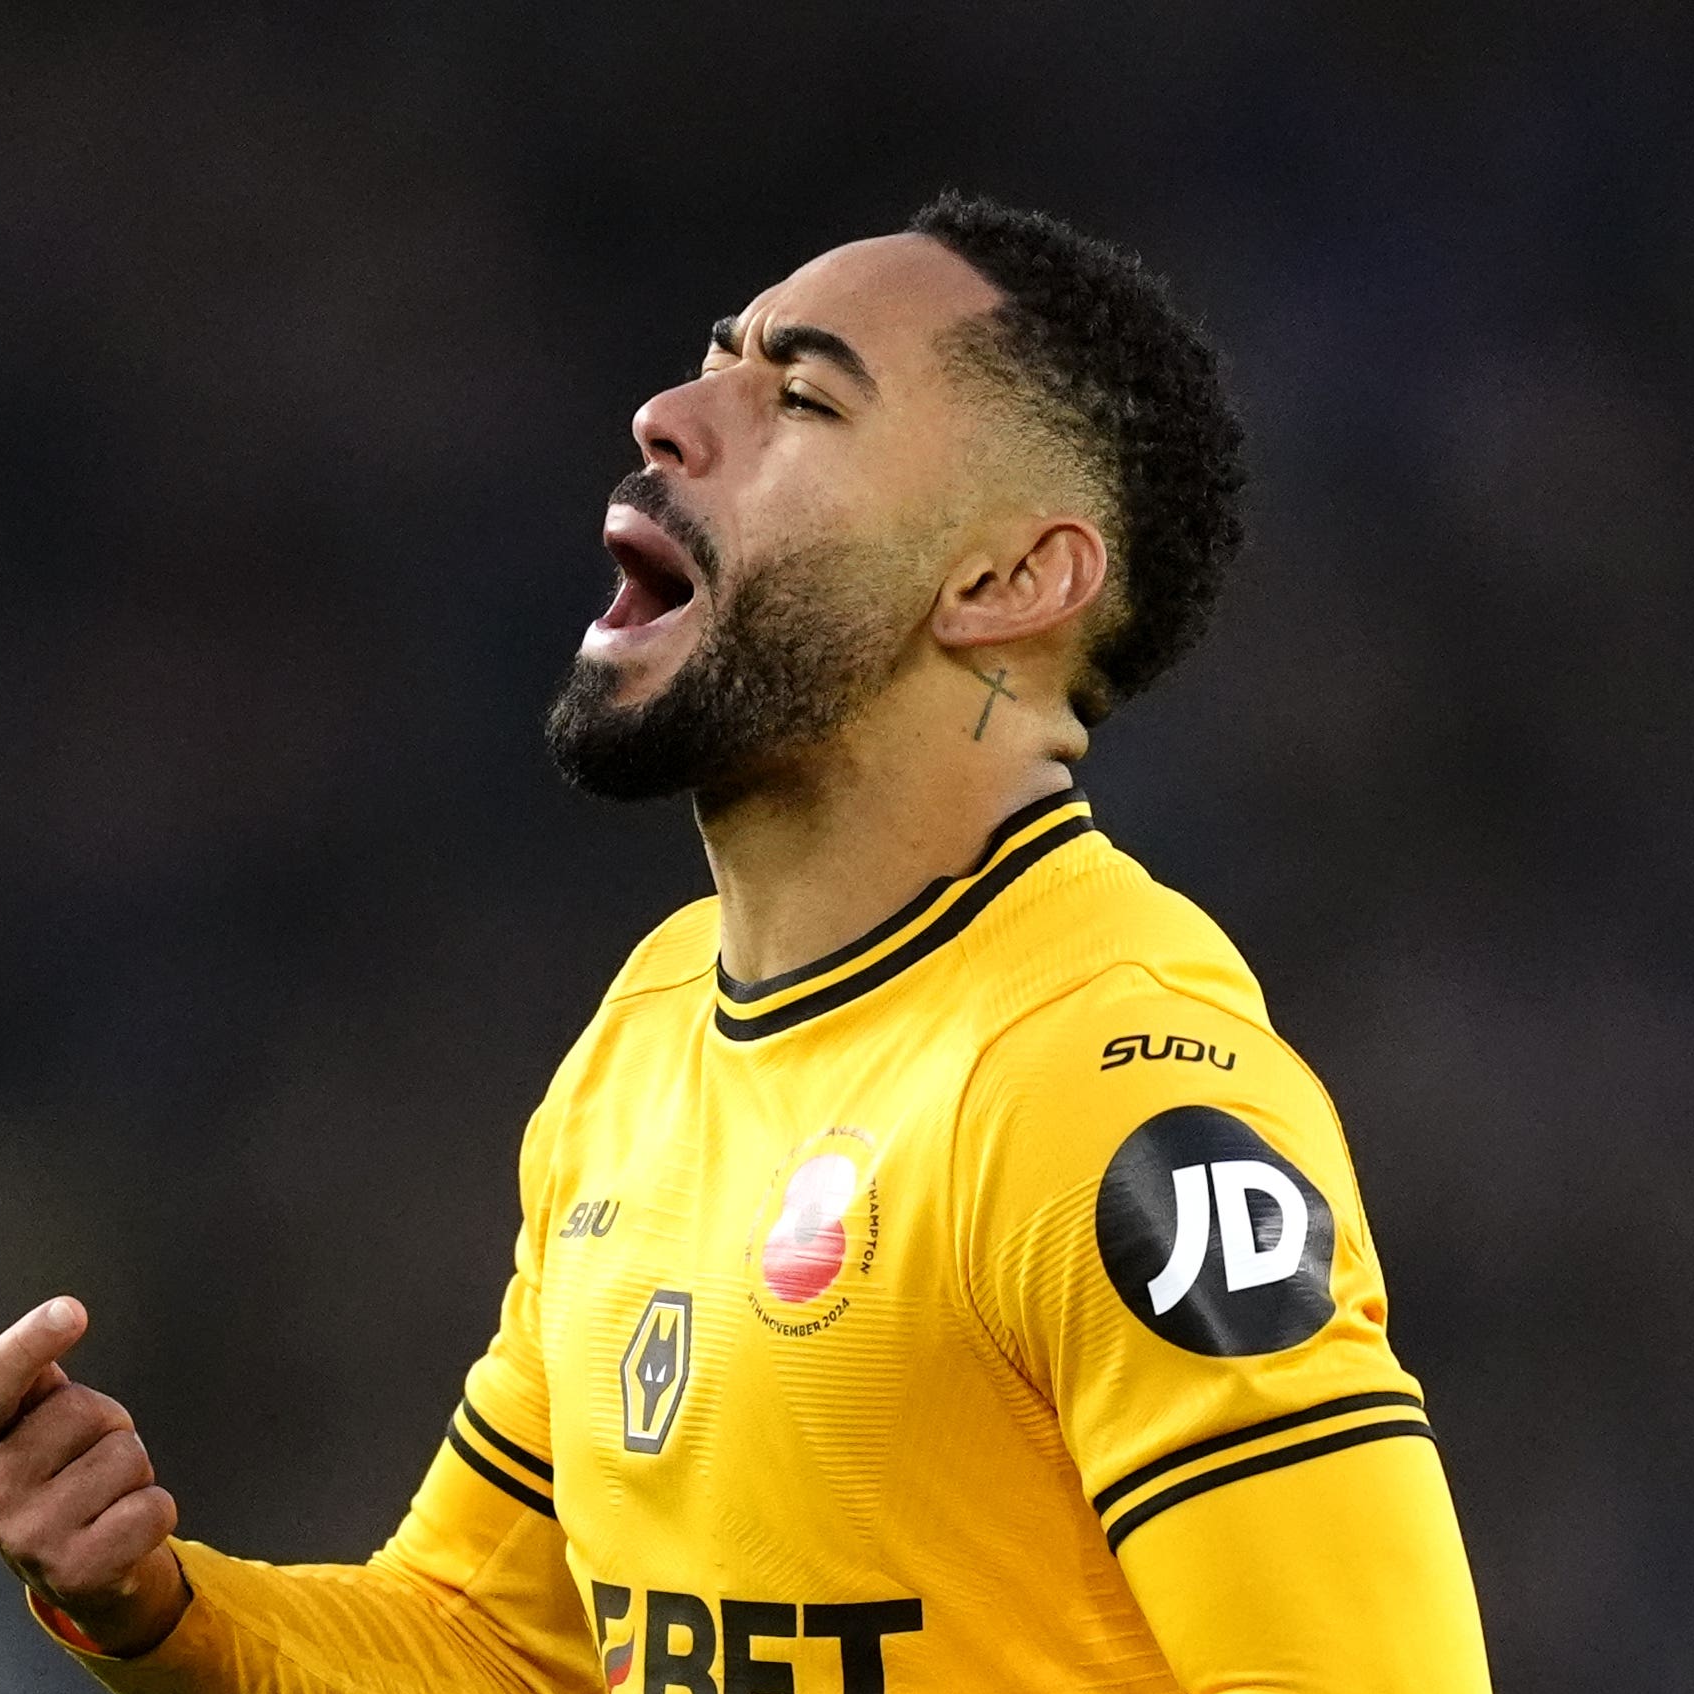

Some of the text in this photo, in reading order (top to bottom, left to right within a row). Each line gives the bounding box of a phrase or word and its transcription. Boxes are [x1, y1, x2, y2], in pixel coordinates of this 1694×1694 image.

[1100, 1034, 1237, 1072] SUDU
[1147, 1160, 1309, 1316] JD
[761, 1313, 822, 1337] NOVEMBER
[822, 1297, 850, 1328] 2024
